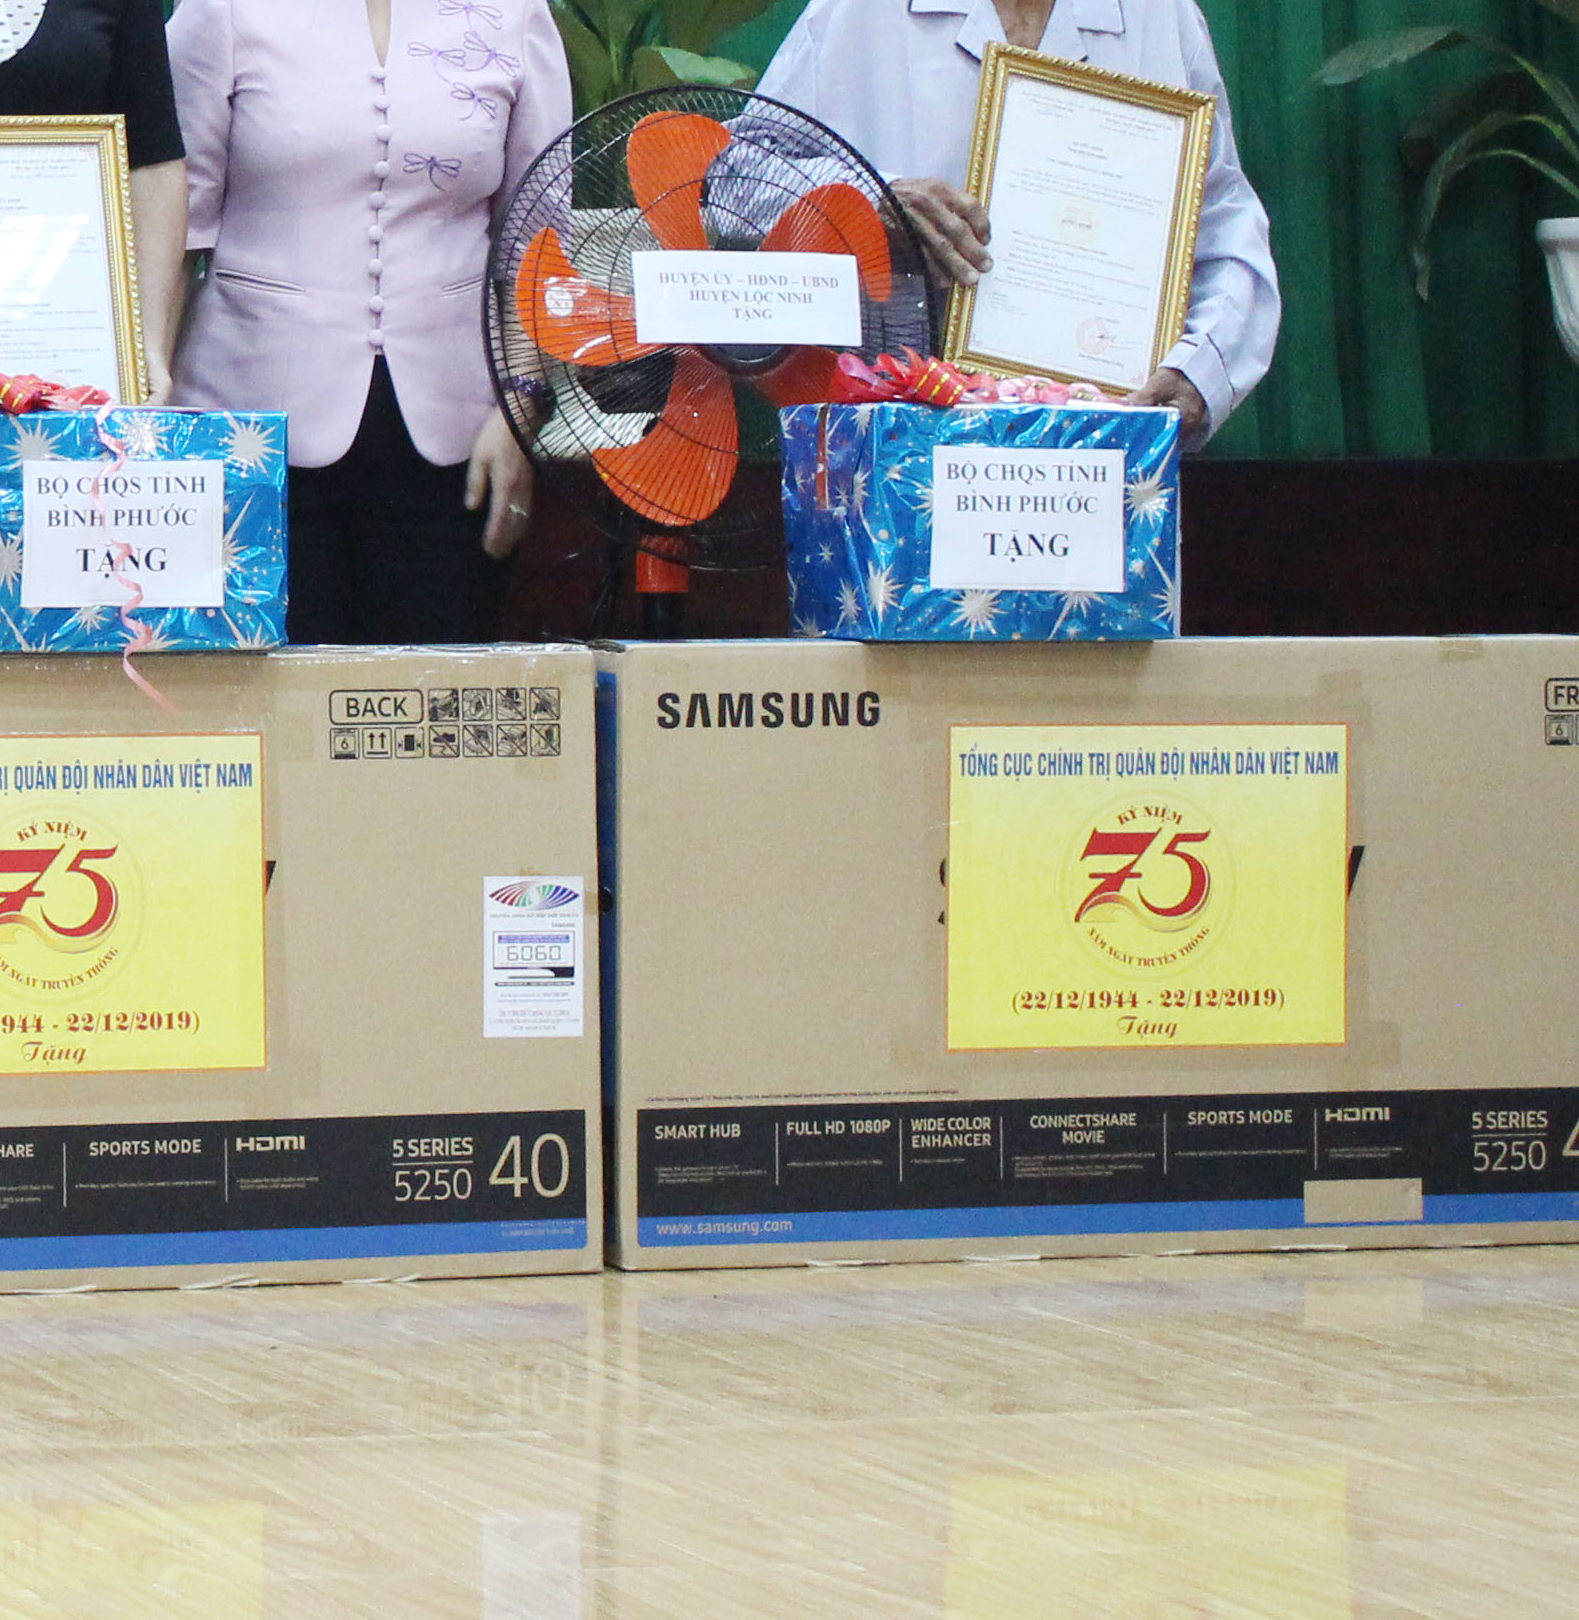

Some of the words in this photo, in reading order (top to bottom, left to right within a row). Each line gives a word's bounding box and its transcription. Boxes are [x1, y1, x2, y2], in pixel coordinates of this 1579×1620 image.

[37, 475, 68, 498] BỘ
[77, 477, 141, 499] CHQS
[946, 461, 977, 484] BỘ
[984, 463, 1046, 486] CHQS
[114, 504, 197, 526] PHƯỚC
[1019, 491, 1098, 513] PHƯỚC
[76, 542, 167, 578] TẶNG
[984, 530, 1070, 562] TẶNG
[346, 697, 408, 718] BACK
[657, 690, 881, 729] SAMSUNG
[960, 743, 998, 777] TỔNG
[1004, 753, 1033, 782] CỤC
[1038, 749, 1082, 776] CHÍNH
[1089, 753, 1111, 781] TRỊ
[1116, 748, 1156, 778] QUÂN
[1161, 748, 1185, 781] ĐỘI
[1190, 747, 1230, 775] NHÂN
[1236, 747, 1265, 775] DÂN
[1270, 747, 1300, 780] VIỆT
[1305, 751, 1338, 775] NAM
[1075, 827, 1211, 923] 75
[393, 1139, 404, 1158] 5
[408, 1137, 473, 1157] SERIES
[489, 1133, 570, 1199] 40
[394, 1168, 472, 1202] 5250
